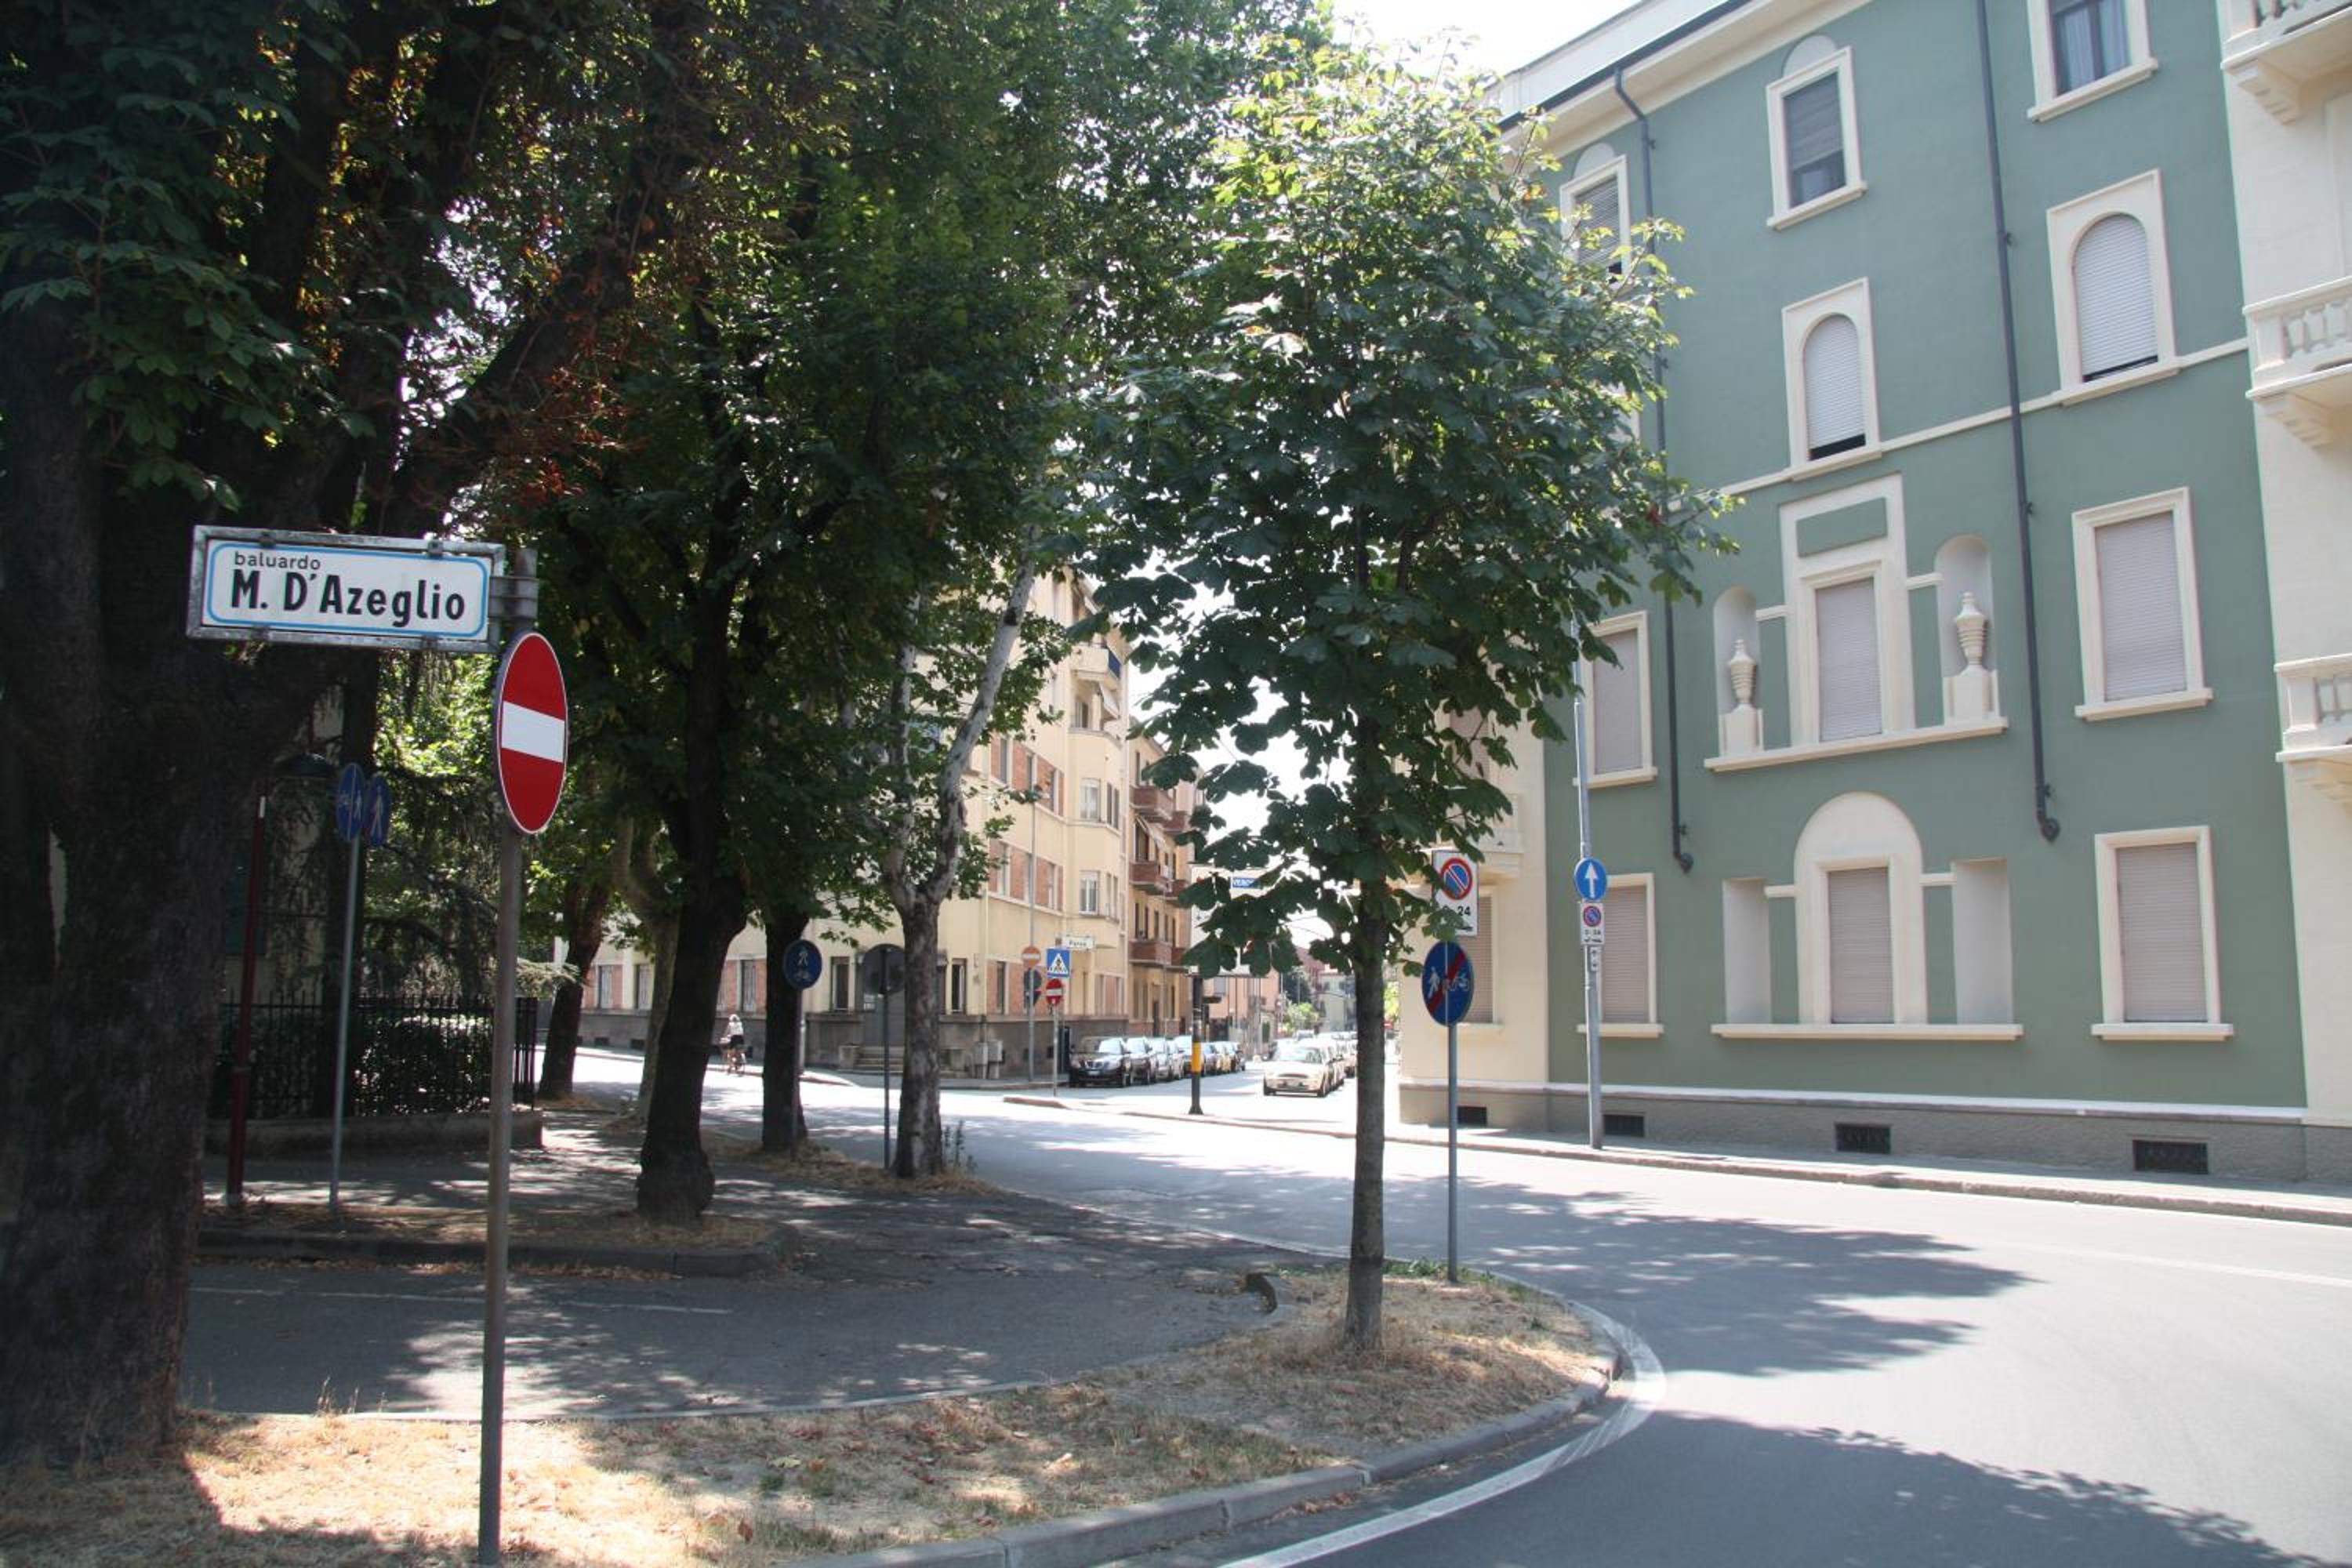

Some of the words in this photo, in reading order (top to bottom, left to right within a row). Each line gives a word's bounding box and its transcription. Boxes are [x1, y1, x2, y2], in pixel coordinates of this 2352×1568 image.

[234, 551, 321, 570] baluardo
[231, 568, 268, 609] M.
[284, 572, 465, 628] D'Azeglio
